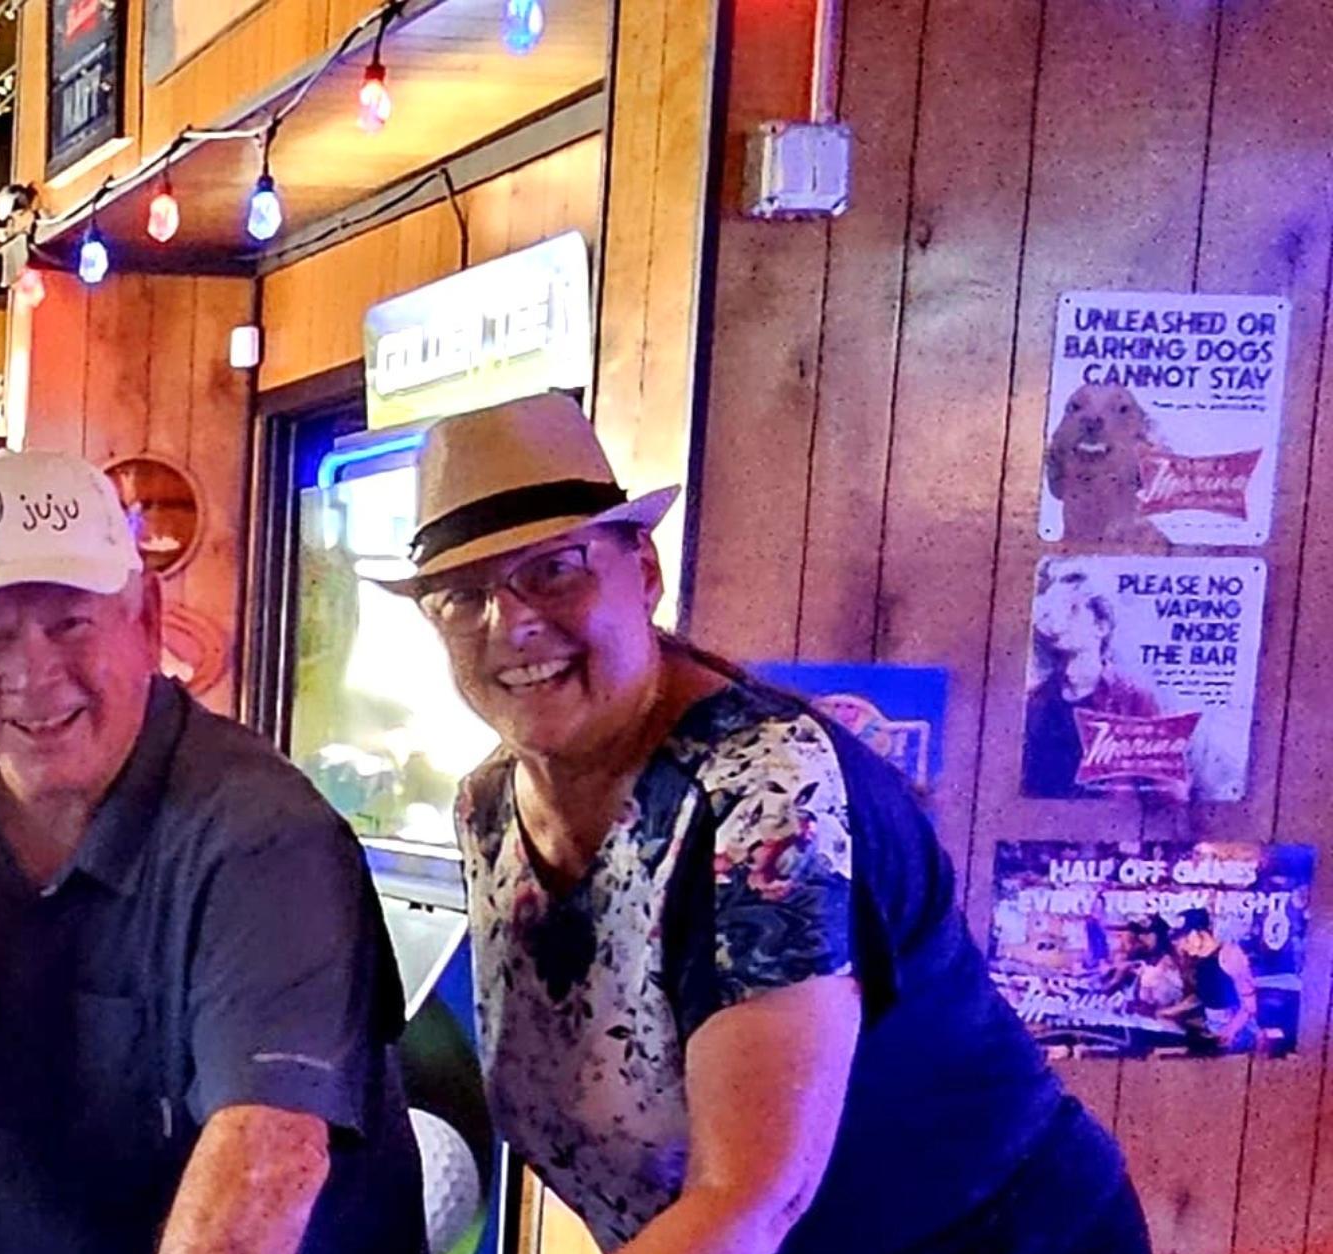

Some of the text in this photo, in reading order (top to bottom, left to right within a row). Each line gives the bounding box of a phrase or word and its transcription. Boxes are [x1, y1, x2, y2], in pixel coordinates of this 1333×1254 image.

[1075, 308, 1277, 336] UNLEASHED OR
[1064, 335, 1273, 364] BARKING DOGS
[1083, 363, 1272, 390] CANNOT STAY
[18, 493, 80, 532] juju
[1117, 574, 1244, 597] PLEASE NO
[1154, 598, 1242, 620] VAPING
[1171, 622, 1241, 643] INSIDE
[1139, 644, 1237, 666] THE BAR
[1048, 858, 1258, 886] HALF OFF GAMES
[1017, 889, 1291, 917] EVERY TUESDAY NIGHT
